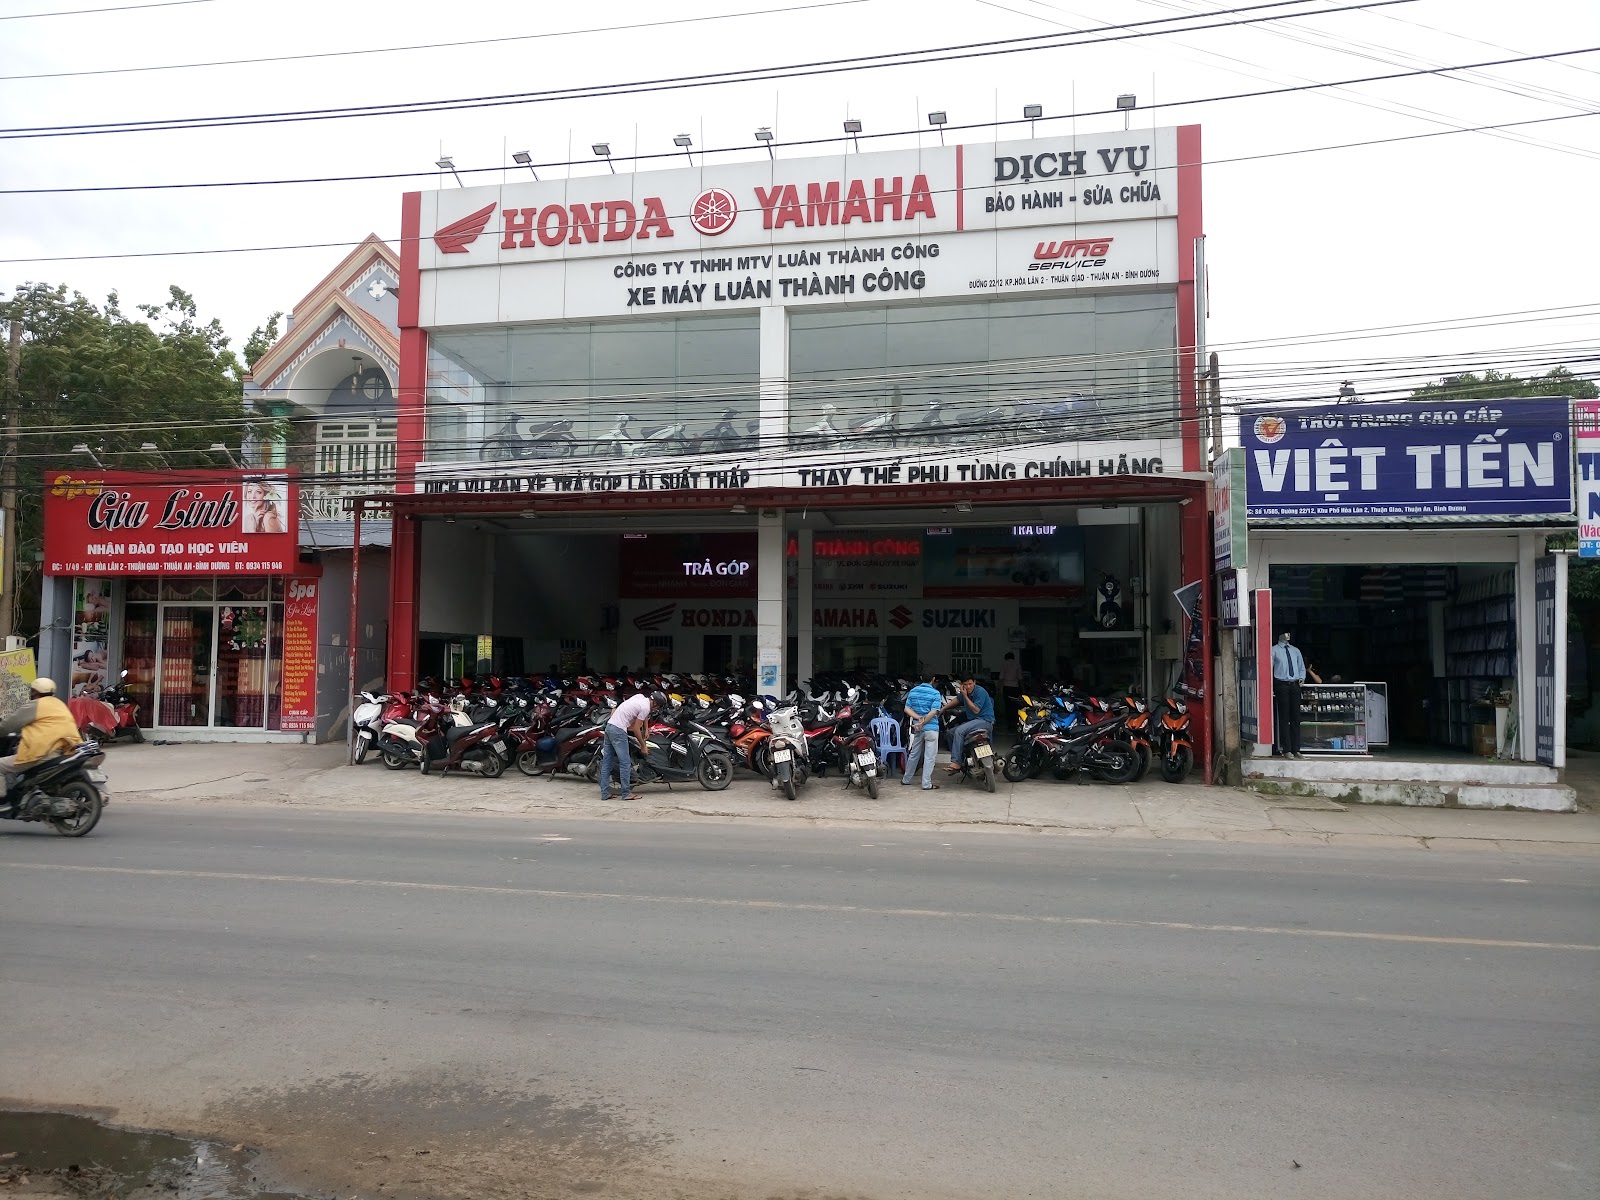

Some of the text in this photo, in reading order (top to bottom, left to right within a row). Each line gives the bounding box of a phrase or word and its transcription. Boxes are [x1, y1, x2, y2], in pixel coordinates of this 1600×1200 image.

[994, 145, 1150, 184] DỊCH VỤ
[754, 174, 936, 229] YAMAHA
[985, 190, 1015, 213] BẢO
[1021, 187, 1063, 210] HÀNH
[1083, 182, 1114, 206] SỬA
[1120, 180, 1161, 203] CHỮA
[501, 197, 674, 249] HONDA
[613, 241, 940, 279] CÔNG TY TNHH MTV LUÂN THÀNH CÔNG
[627, 268, 926, 307] XE MÁY LUÂN THÀNH CÔNG
[1418, 410, 1458, 426] CAO
[659, 467, 700, 490] SUẤT
[707, 465, 750, 489] THẤP
[798, 468, 852, 486] THAY
[957, 459, 1016, 482] TÙNG
[1024, 456, 1091, 479] CHÍNH
[1098, 454, 1163, 476] HÃNG
[1253, 438, 1386, 501] VIỆT
[1406, 428, 1554, 489] TIẾN
[50, 474, 103, 500] Spa
[87, 488, 239, 531] Gia Linh
[87, 540, 248, 557] NHẬN ĐÀO TẠO HỌC VIÊN
[184, 562, 192, 571] AN
[260, 562, 270, 570] 115
[682, 558, 750, 576] TRẢ GÓP
[288, 579, 316, 602] Spa
[681, 608, 758, 628] HONDA
[813, 608, 878, 628] AMAHA
[922, 608, 996, 628] SUZUKI
